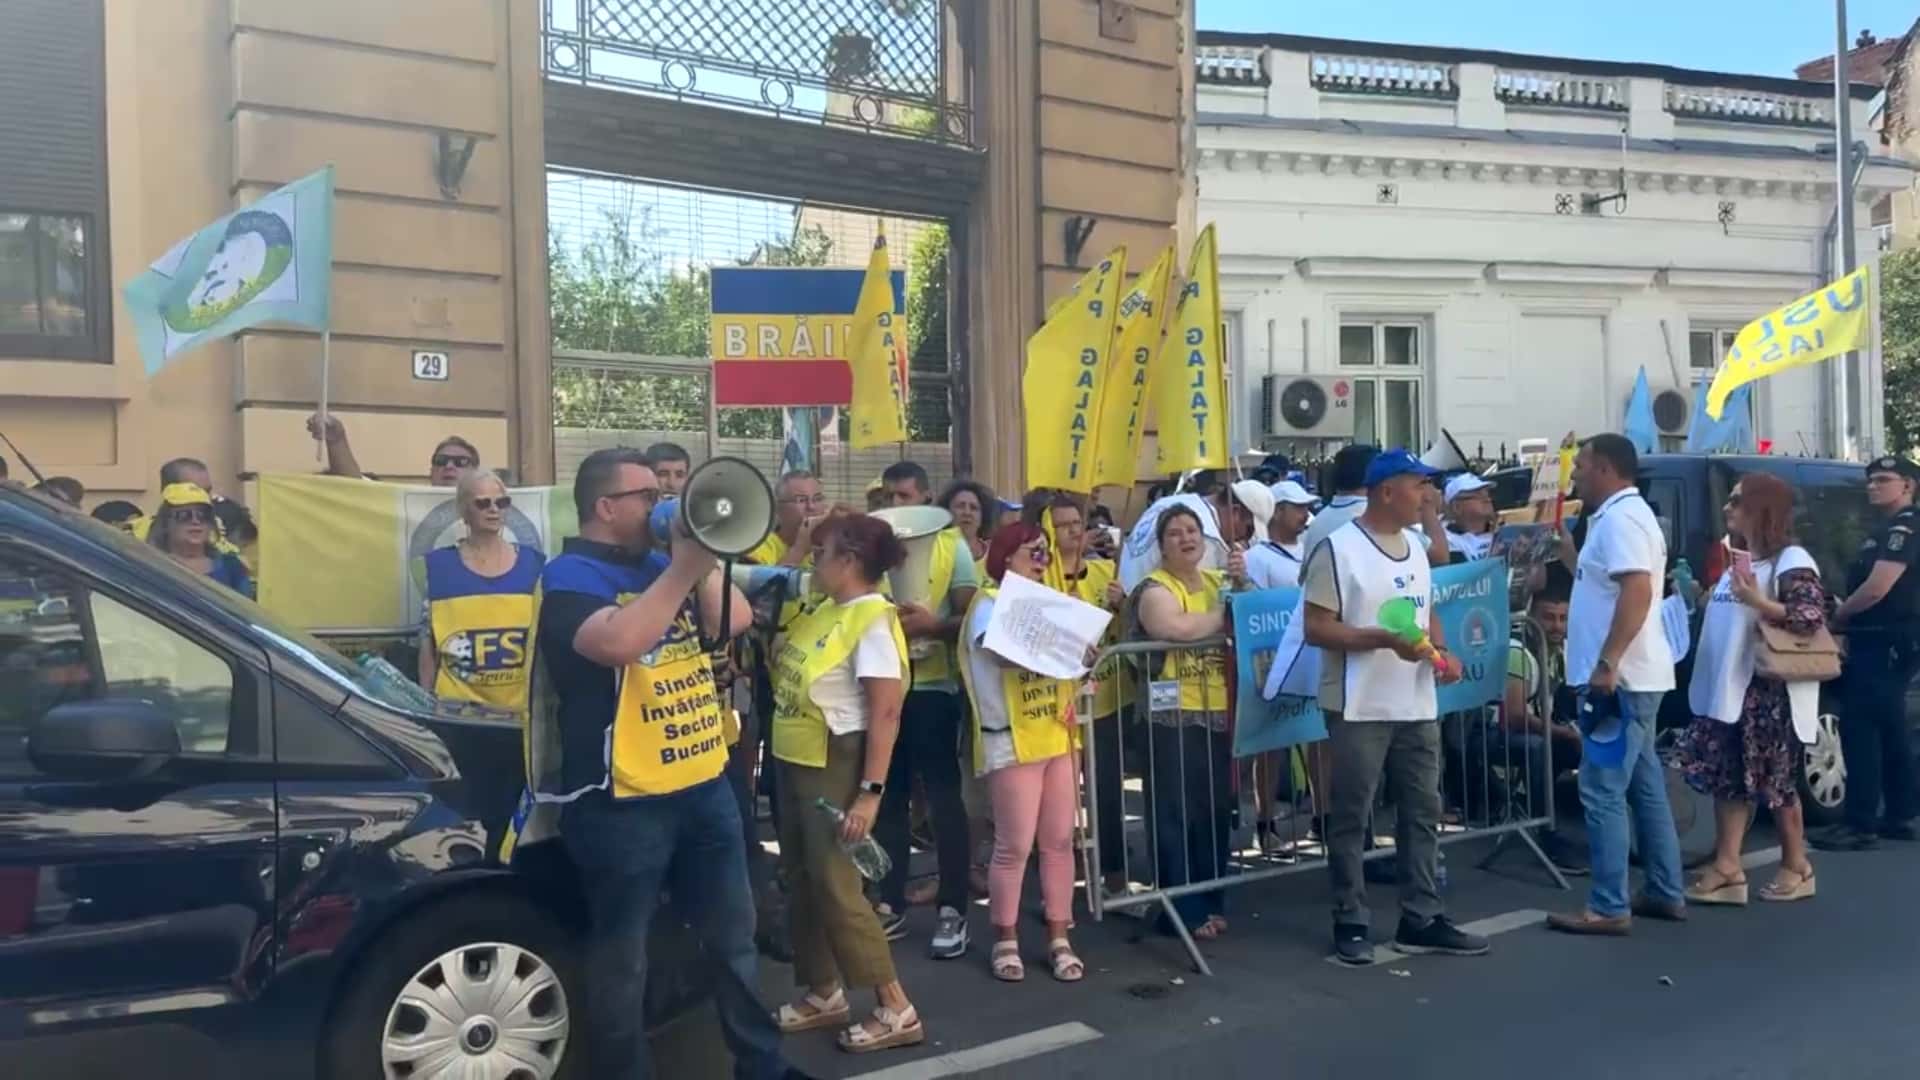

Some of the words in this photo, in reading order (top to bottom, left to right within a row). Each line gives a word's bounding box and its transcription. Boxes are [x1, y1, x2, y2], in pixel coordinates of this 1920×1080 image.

[421, 354, 441, 376] 29
[1335, 400, 1348, 408] LG
[1248, 608, 1295, 634] SIND
